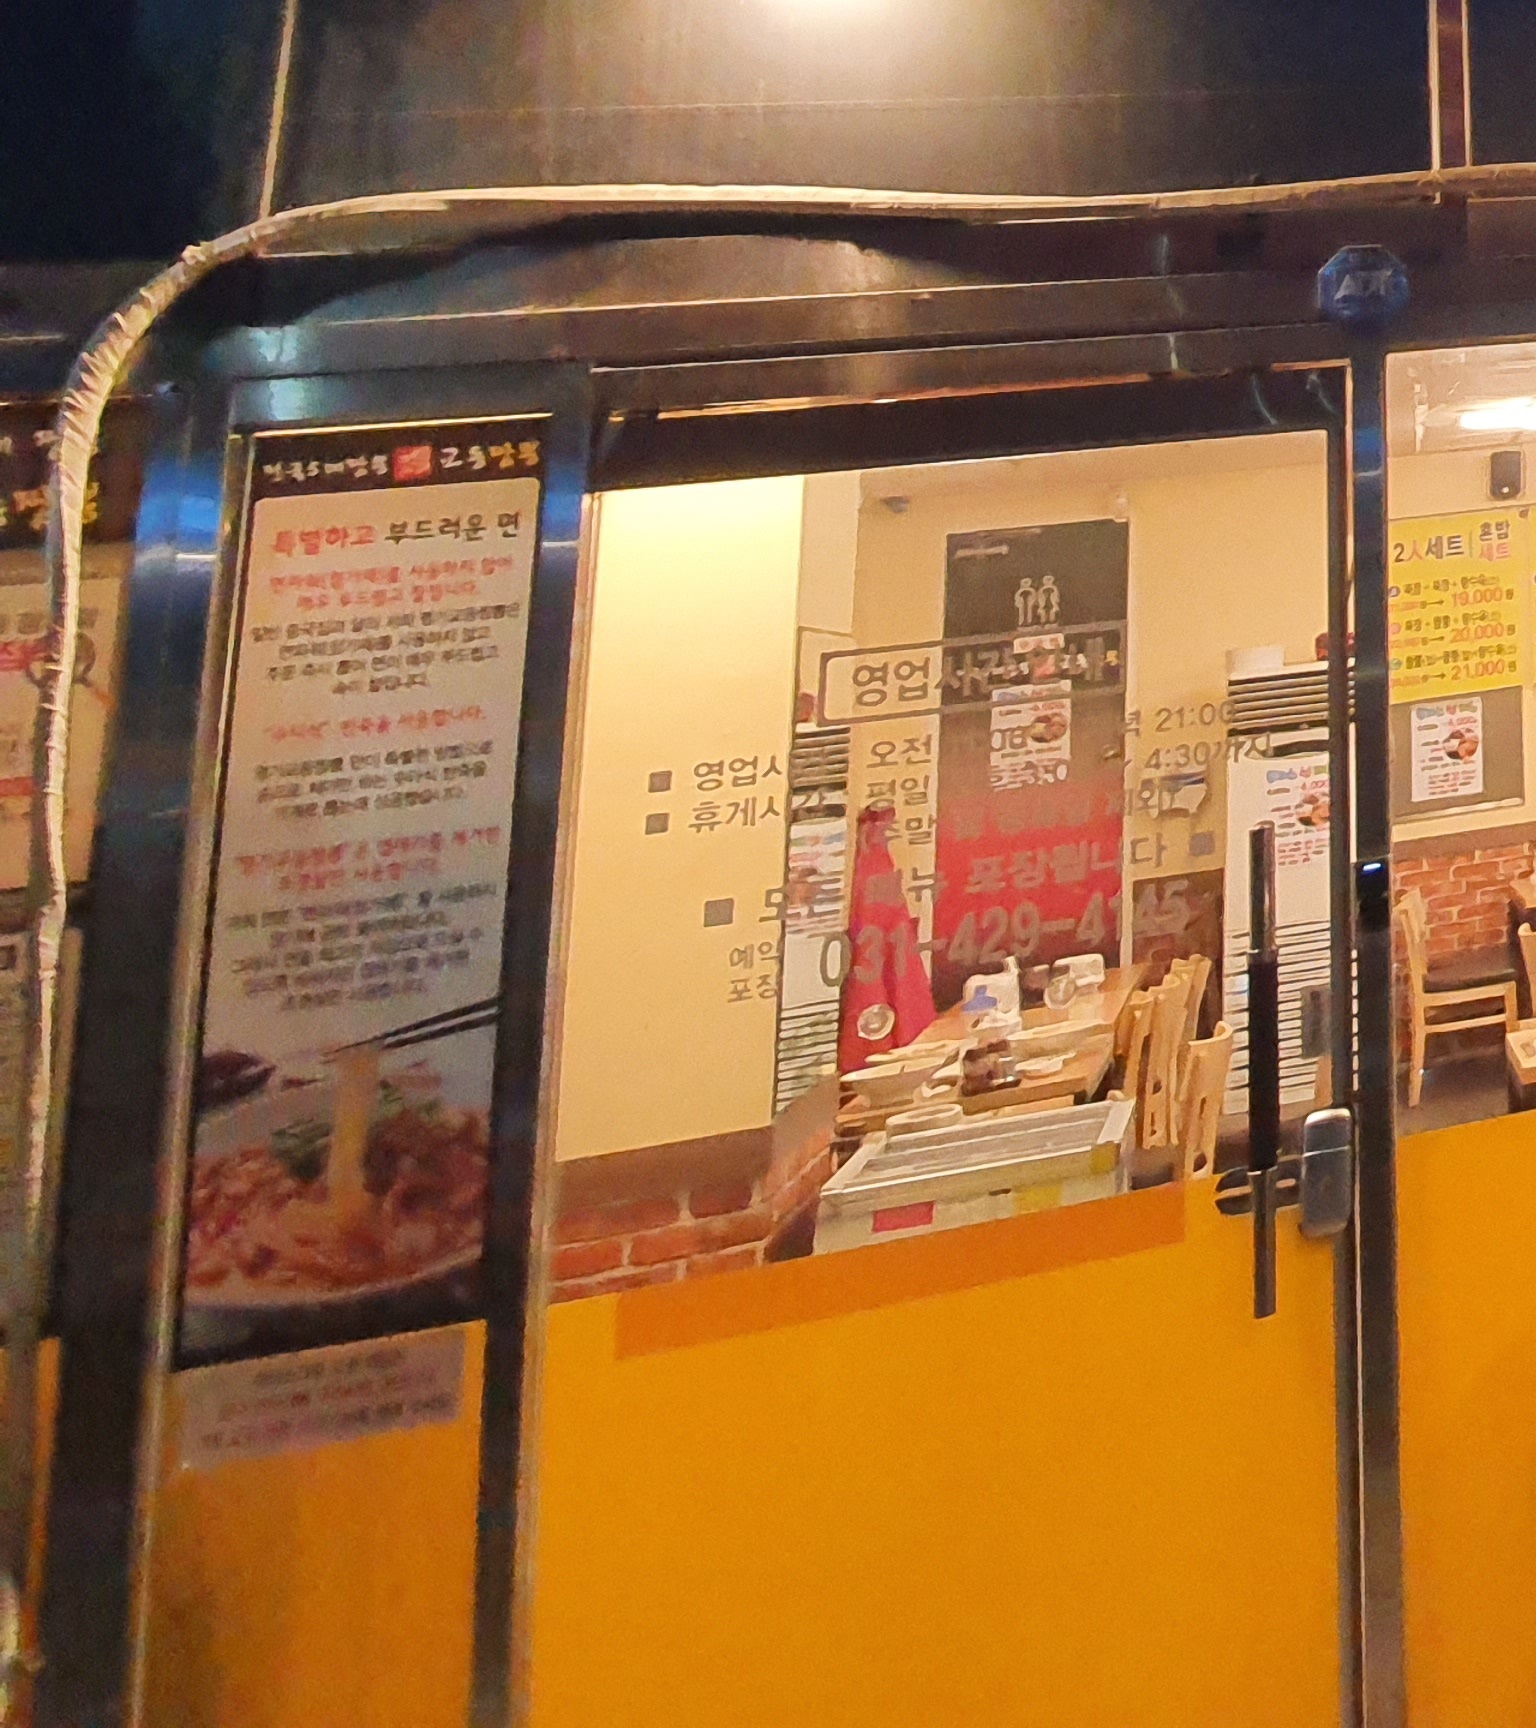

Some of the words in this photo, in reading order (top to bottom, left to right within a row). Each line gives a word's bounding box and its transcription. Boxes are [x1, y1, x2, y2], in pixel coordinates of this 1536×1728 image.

[384, 513, 487, 545] 부드러운
[496, 511, 521, 539] 면
[866, 733, 932, 770] 오전
[693, 755, 786, 792] 영업시
[866, 774, 931, 812] 평일
